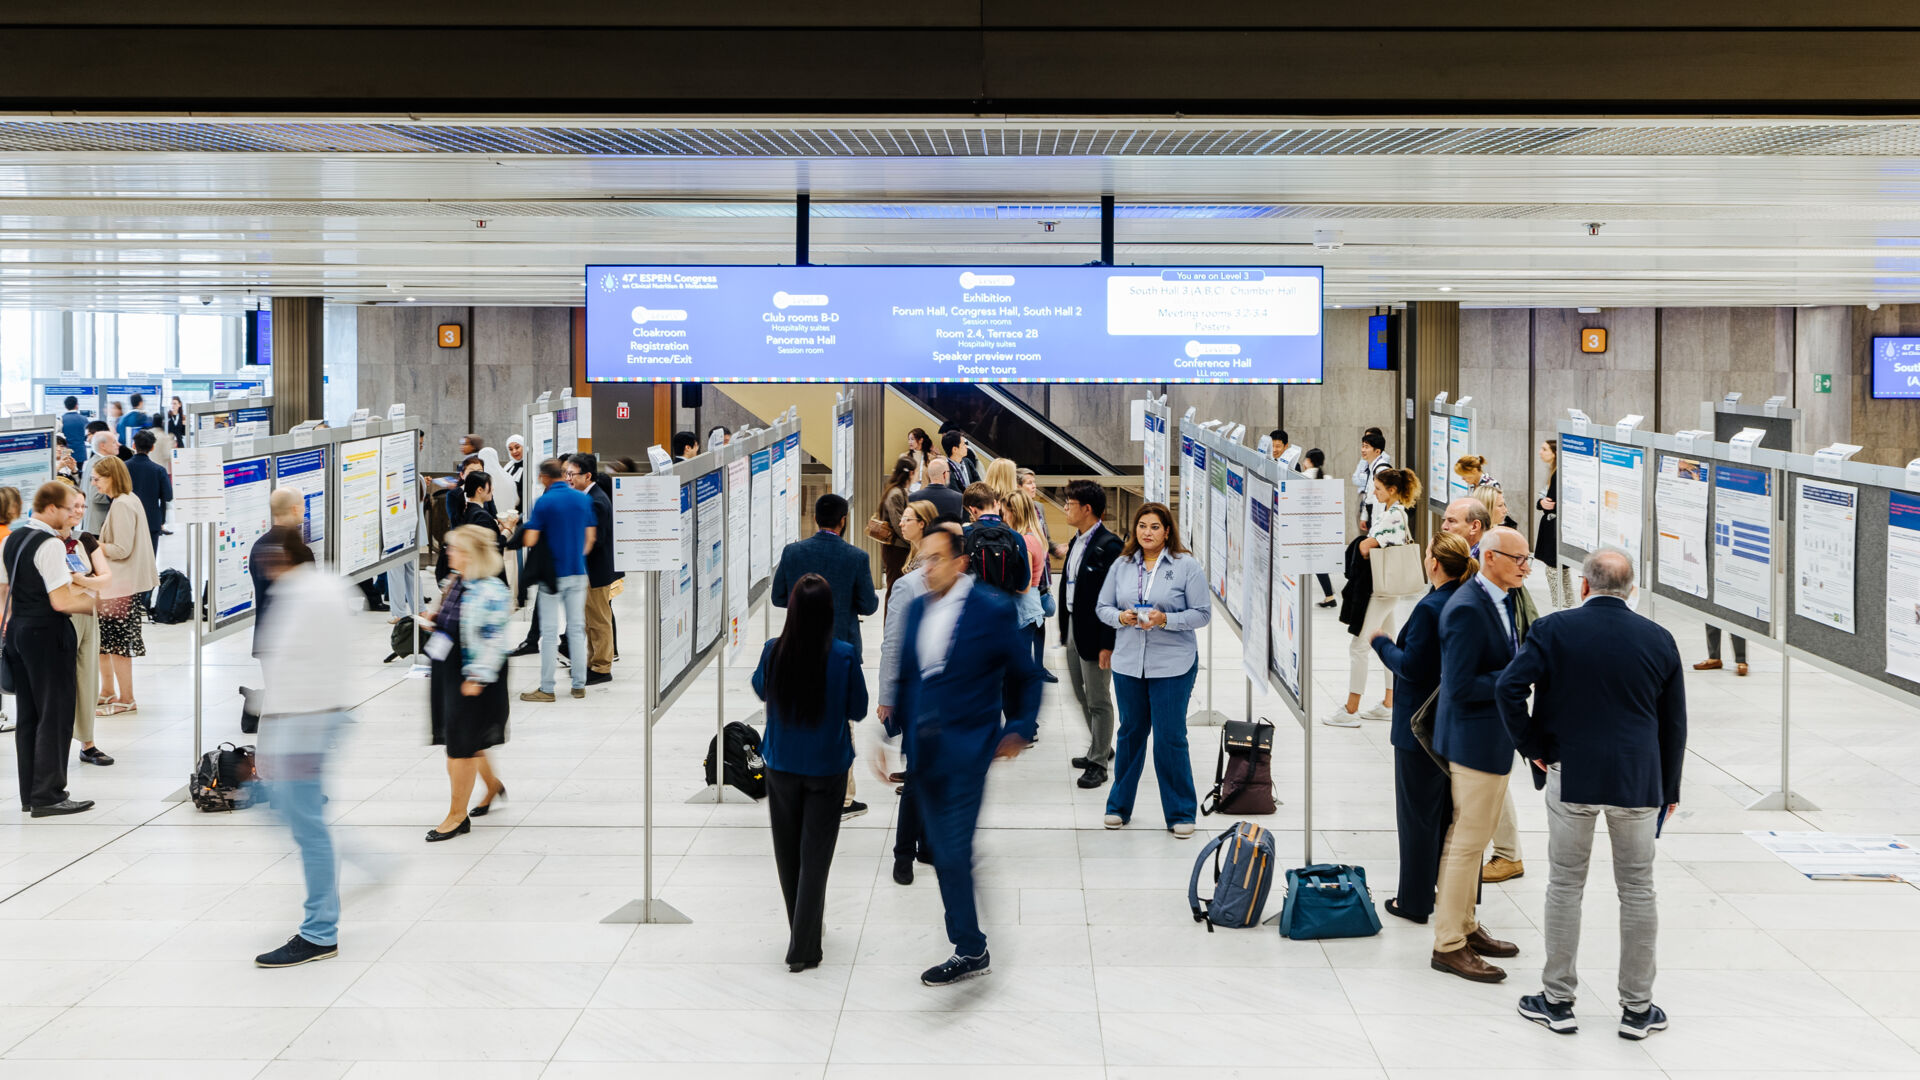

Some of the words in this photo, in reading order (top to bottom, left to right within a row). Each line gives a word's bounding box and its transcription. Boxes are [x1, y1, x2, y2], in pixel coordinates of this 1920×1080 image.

[639, 273, 672, 283] ESPEN
[673, 273, 718, 285] Congress
[1177, 271, 1192, 280] You
[1221, 271, 1242, 280] Level
[1244, 271, 1250, 280] 3
[1129, 286, 1158, 296] South
[1160, 286, 1179, 295] Hall
[1182, 286, 1188, 295] 3
[1231, 286, 1275, 296] Chamber
[1276, 286, 1297, 295] Hall
[963, 292, 1012, 303] Exhibition
[762, 311, 786, 323] Club
[787, 314, 819, 323] rooms
[820, 312, 840, 323] B-D
[892, 306, 925, 316] Forum
[926, 305, 949, 318] Hall,
[950, 306, 997, 319] Congress
[999, 305, 1021, 318] Hall,
[1023, 306, 1052, 316] South
[1054, 305, 1074, 316] Hall
[1075, 306, 1083, 316] 2
[1158, 308, 1198, 320] Meeting
[962, 317, 988, 325] Session
[1194, 322, 1231, 331] Posters
[632, 327, 687, 338] Cloakroom
[771, 324, 809, 333] Hospitality
[810, 324, 831, 332] suites
[936, 328, 965, 339] Room
[966, 328, 985, 340] 2.4,
[987, 329, 1024, 339] Terrace
[1025, 328, 1039, 339] 2B
[445, 330, 455, 343] 3
[766, 335, 815, 345] Panorama
[816, 334, 836, 345] Hall
[1588, 334, 1599, 348] 3
[630, 340, 689, 353] Registration
[957, 339, 994, 349] Hospitality
[996, 340, 1017, 348] suites
[777, 346, 804, 354] Session
[626, 354, 693, 365] Entrance/Exit
[932, 351, 972, 363] Speaker
[974, 351, 1014, 363] preview
[1015, 353, 1042, 362] room
[1174, 358, 1231, 368] Conference
[1232, 357, 1252, 368] Hall
[957, 364, 990, 375] Poster
[991, 365, 1017, 375] tours
[1196, 369, 1209, 377] LLL
